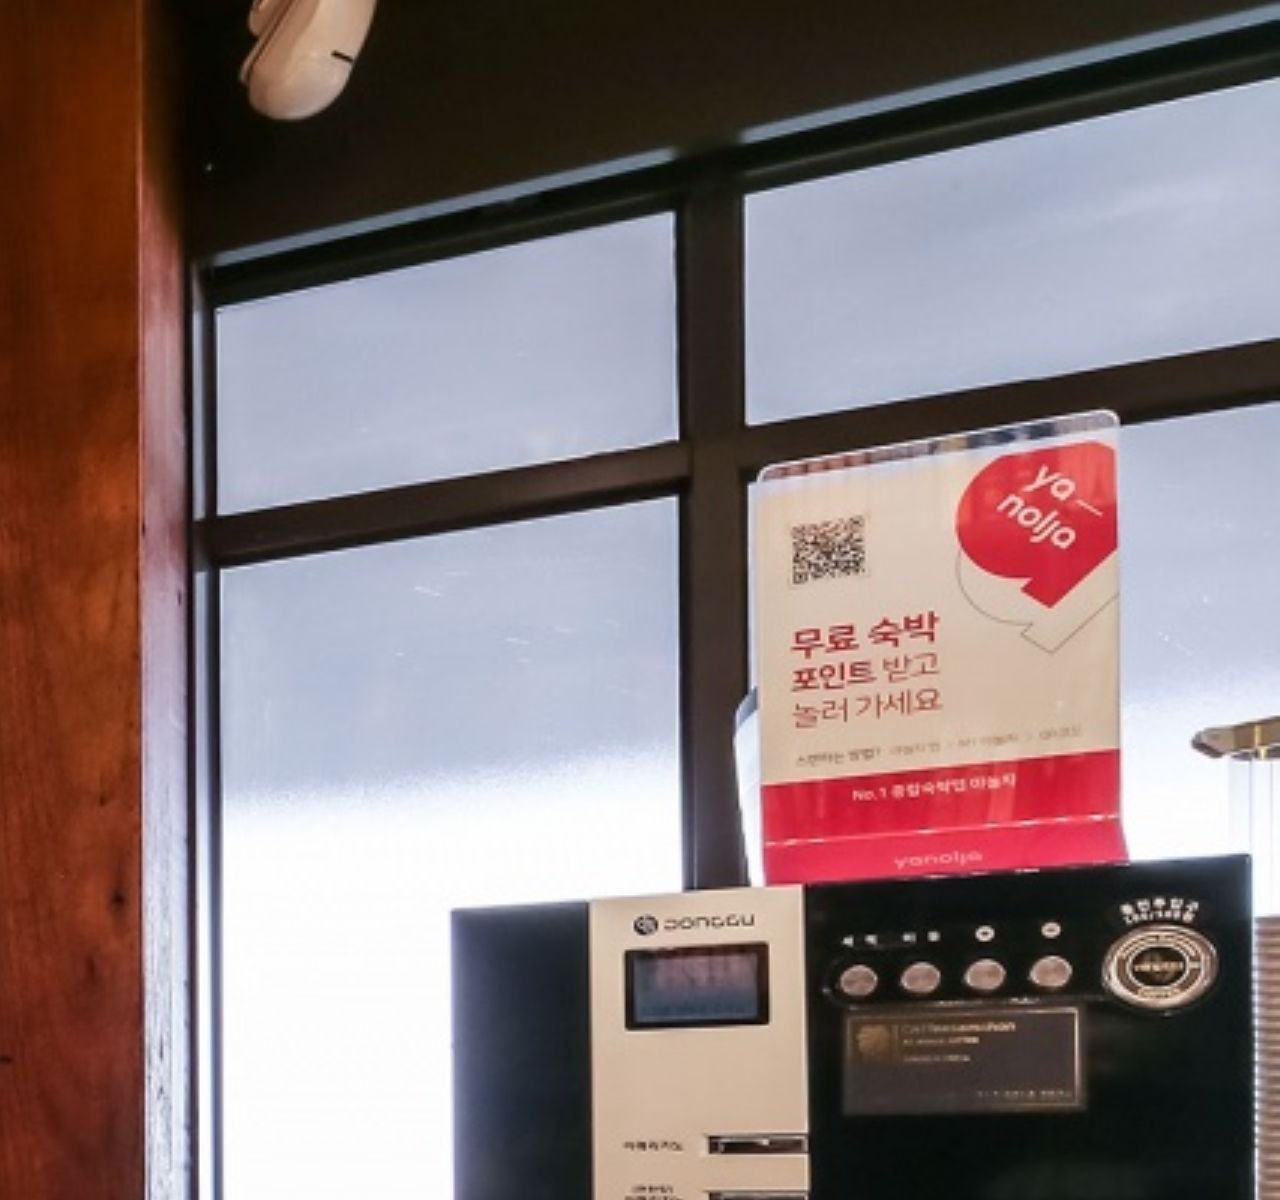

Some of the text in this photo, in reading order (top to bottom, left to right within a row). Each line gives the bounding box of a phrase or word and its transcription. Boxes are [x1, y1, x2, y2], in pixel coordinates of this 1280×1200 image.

[996, 493, 1077, 550] nolja
[790, 610, 940, 660] 무료 숙박
[791, 652, 940, 692] 포인트 받고
[792, 688, 944, 730] 놀러 가세요
[894, 850, 983, 871] yanolja
